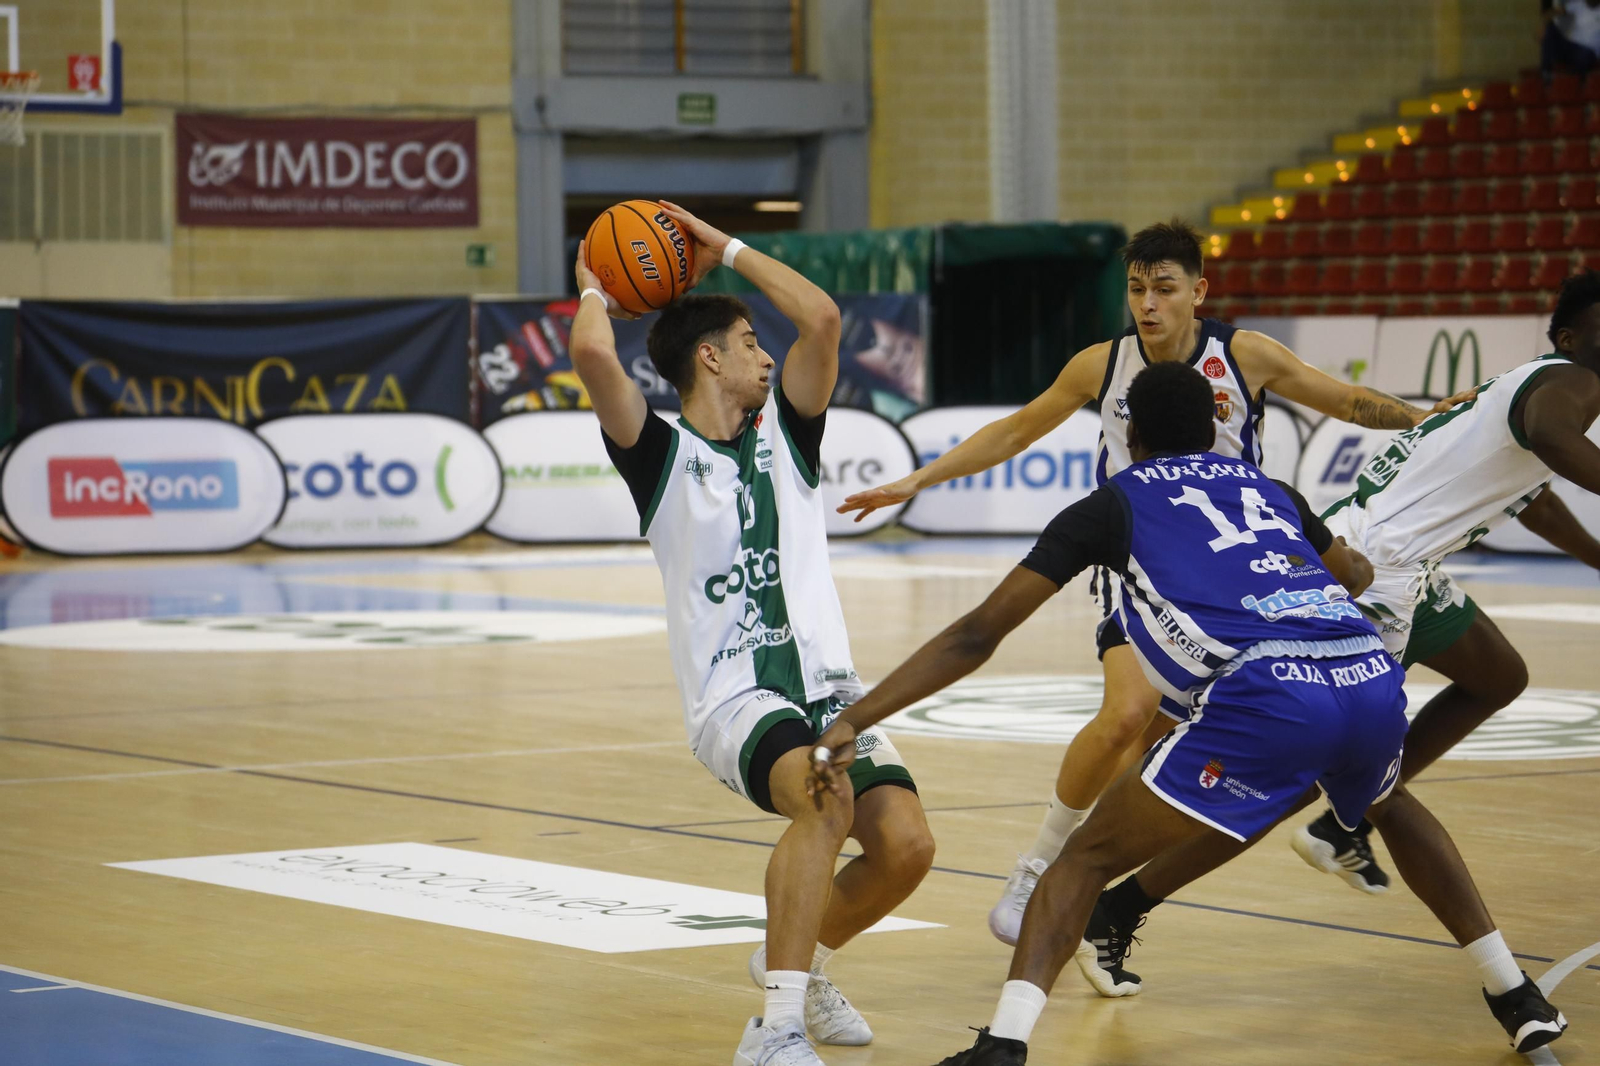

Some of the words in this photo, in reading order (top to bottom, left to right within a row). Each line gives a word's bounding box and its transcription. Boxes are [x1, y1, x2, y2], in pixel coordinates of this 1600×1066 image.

[255, 141, 468, 189] IMDECO
[630, 240, 660, 281] EVO
[653, 211, 688, 284] Wilson
[1168, 485, 1302, 553] 14
[704, 549, 780, 604] coto
[1241, 588, 1326, 614] intra
[1317, 601, 1363, 621] gas
[711, 624, 793, 667] ATRESVEGA
[1157, 609, 1207, 662] REDYTEL
[1271, 661, 1329, 685] CAJA
[1225, 775, 1270, 801] universidad
[1229, 784, 1247, 799] león
